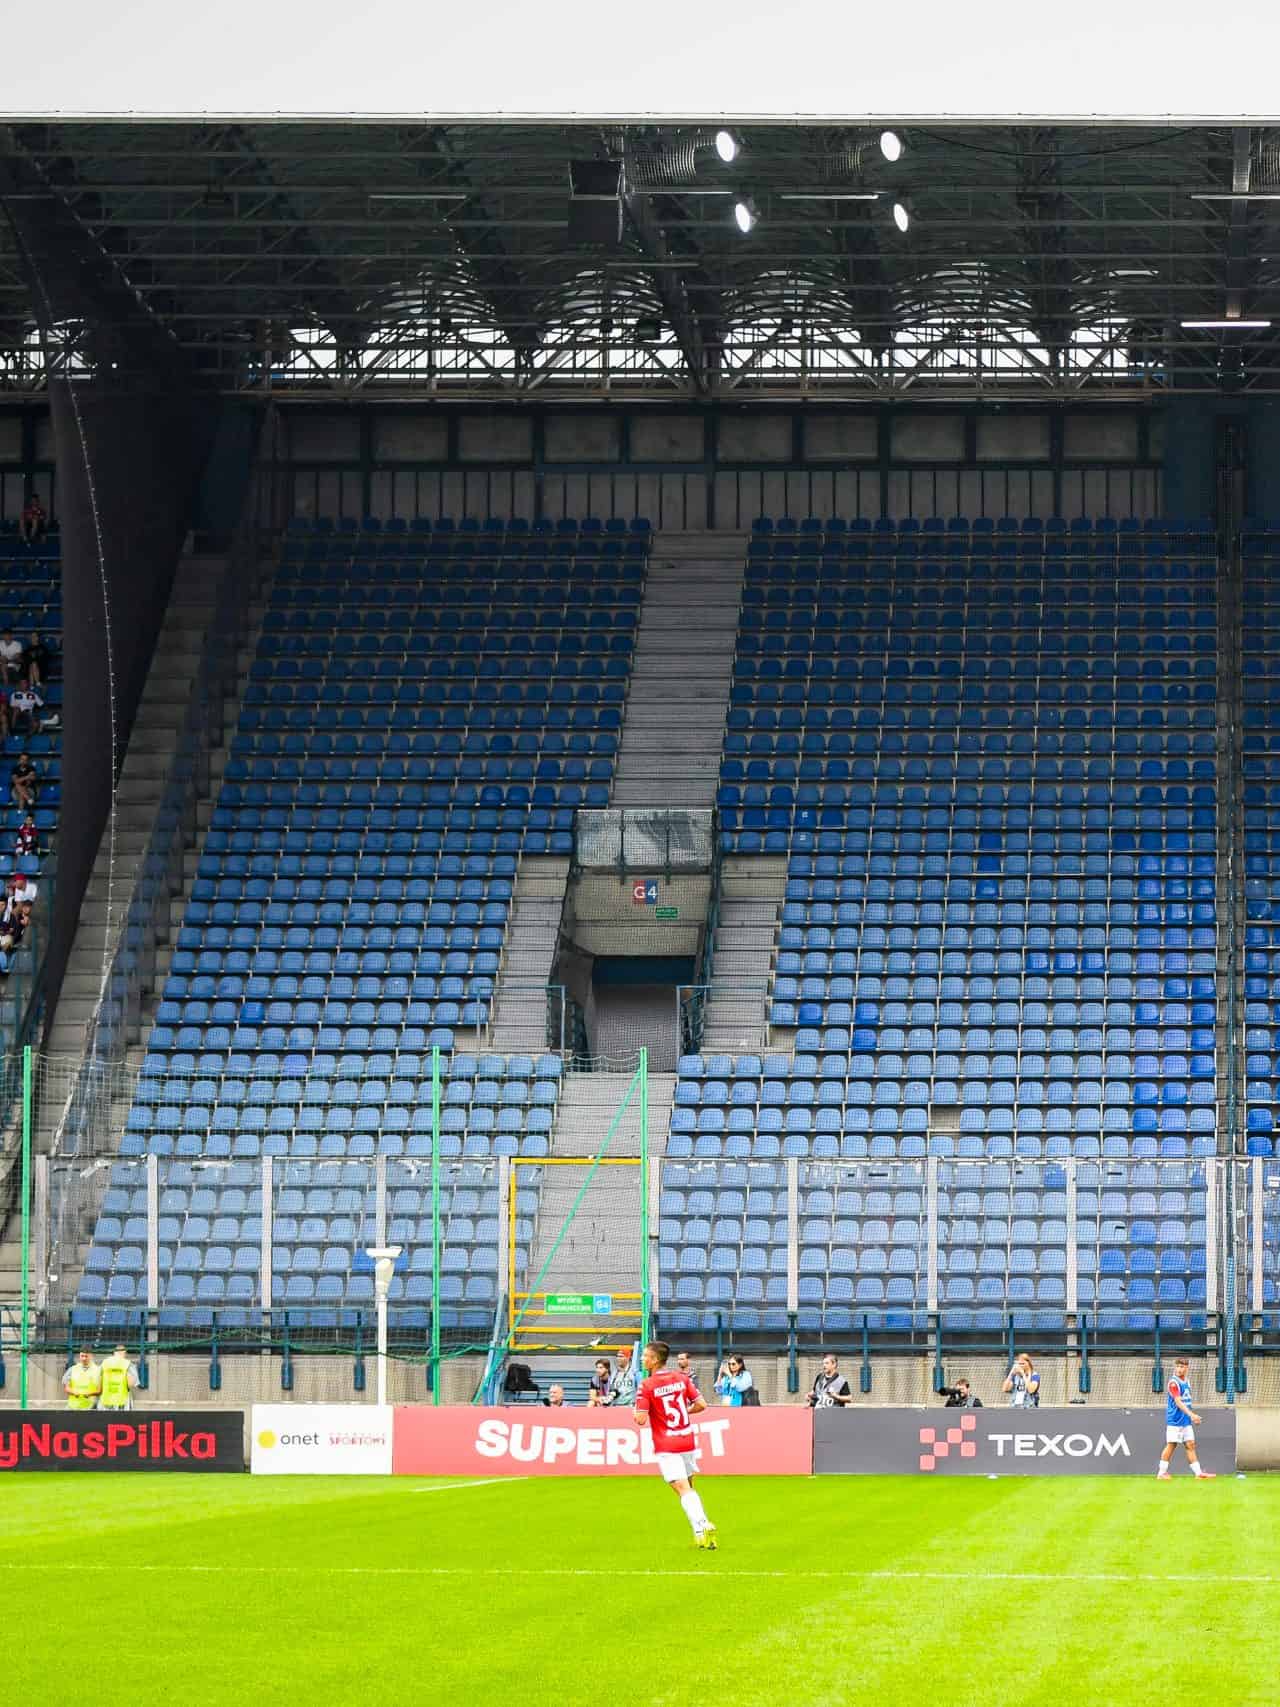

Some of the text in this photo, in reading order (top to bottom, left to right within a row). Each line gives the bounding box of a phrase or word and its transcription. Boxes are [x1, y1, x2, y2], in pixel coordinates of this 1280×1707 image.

[633, 885, 658, 900] G4
[660, 1392, 690, 1429] 51
[280, 1432, 320, 1446] onet
[475, 1419, 729, 1465] SUPERT
[988, 1433, 1131, 1457] TEXOM
